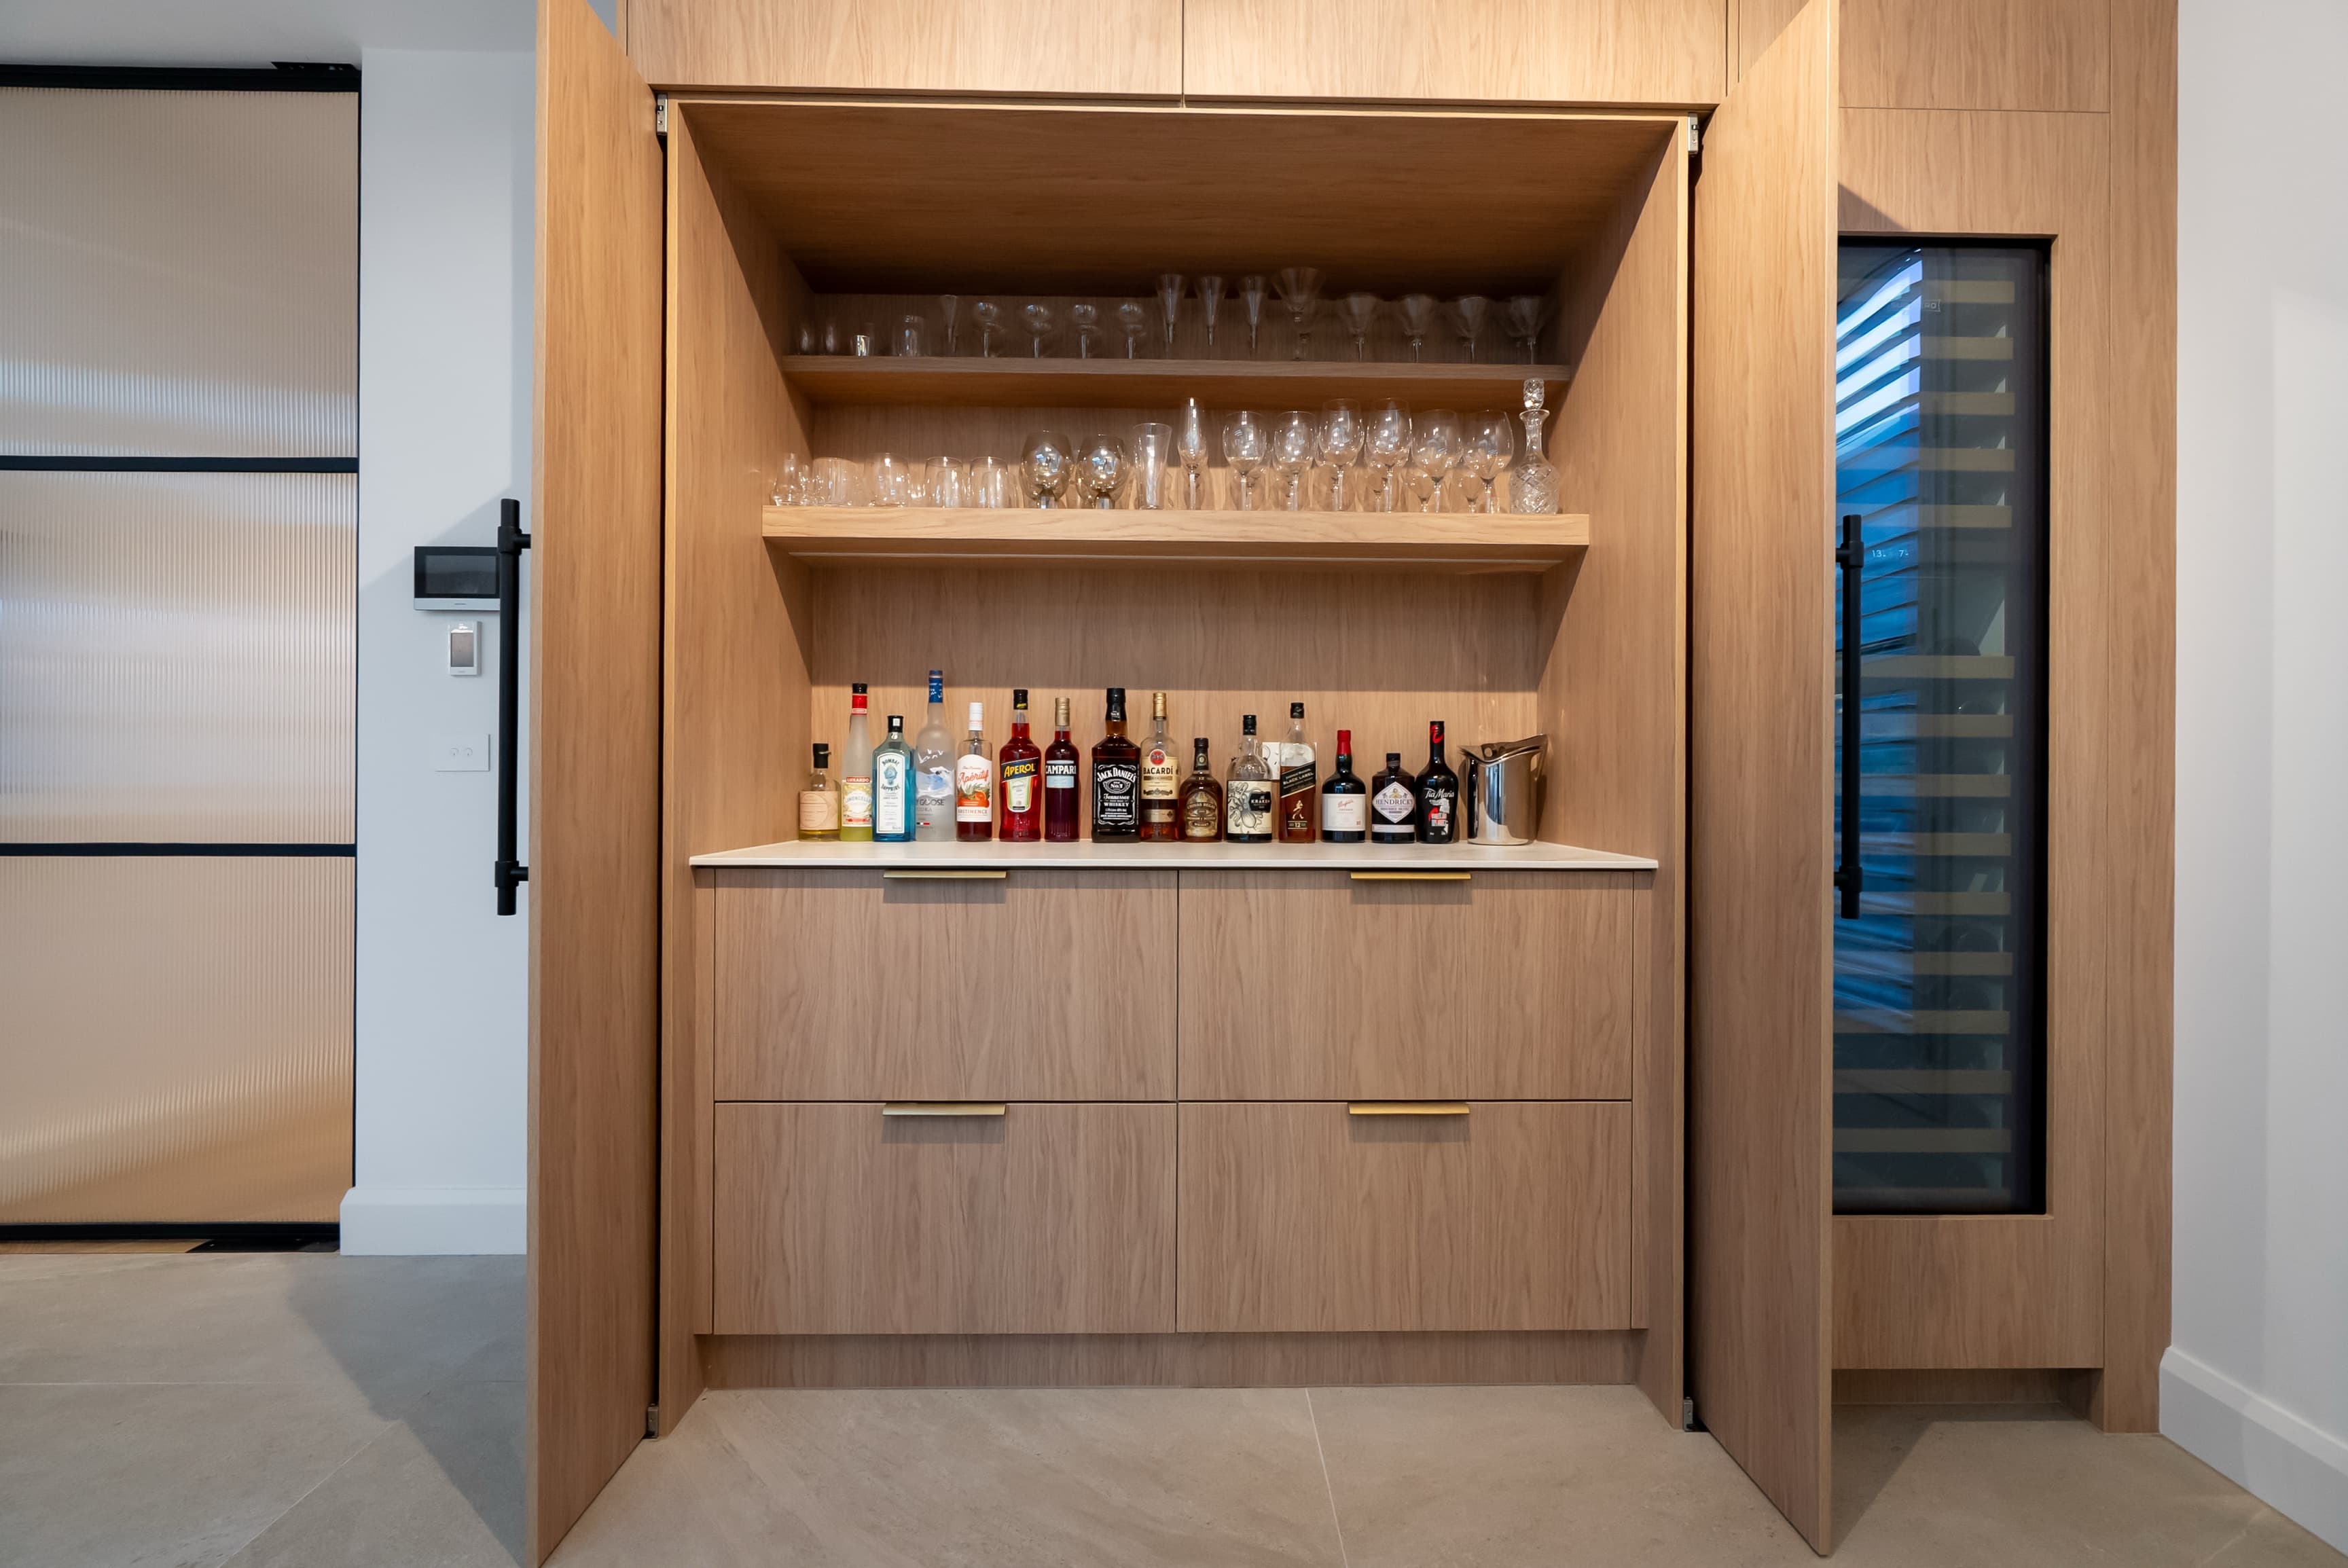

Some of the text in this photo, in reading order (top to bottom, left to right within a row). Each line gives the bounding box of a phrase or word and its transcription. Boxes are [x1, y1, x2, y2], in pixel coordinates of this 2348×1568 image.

[1004, 763, 1035, 778] APEROL
[1097, 767, 1136, 782] JACK DANIEL'S
[1143, 766, 1173, 774] BACARDÍ
[1424, 788, 1455, 799] Tia Maria
